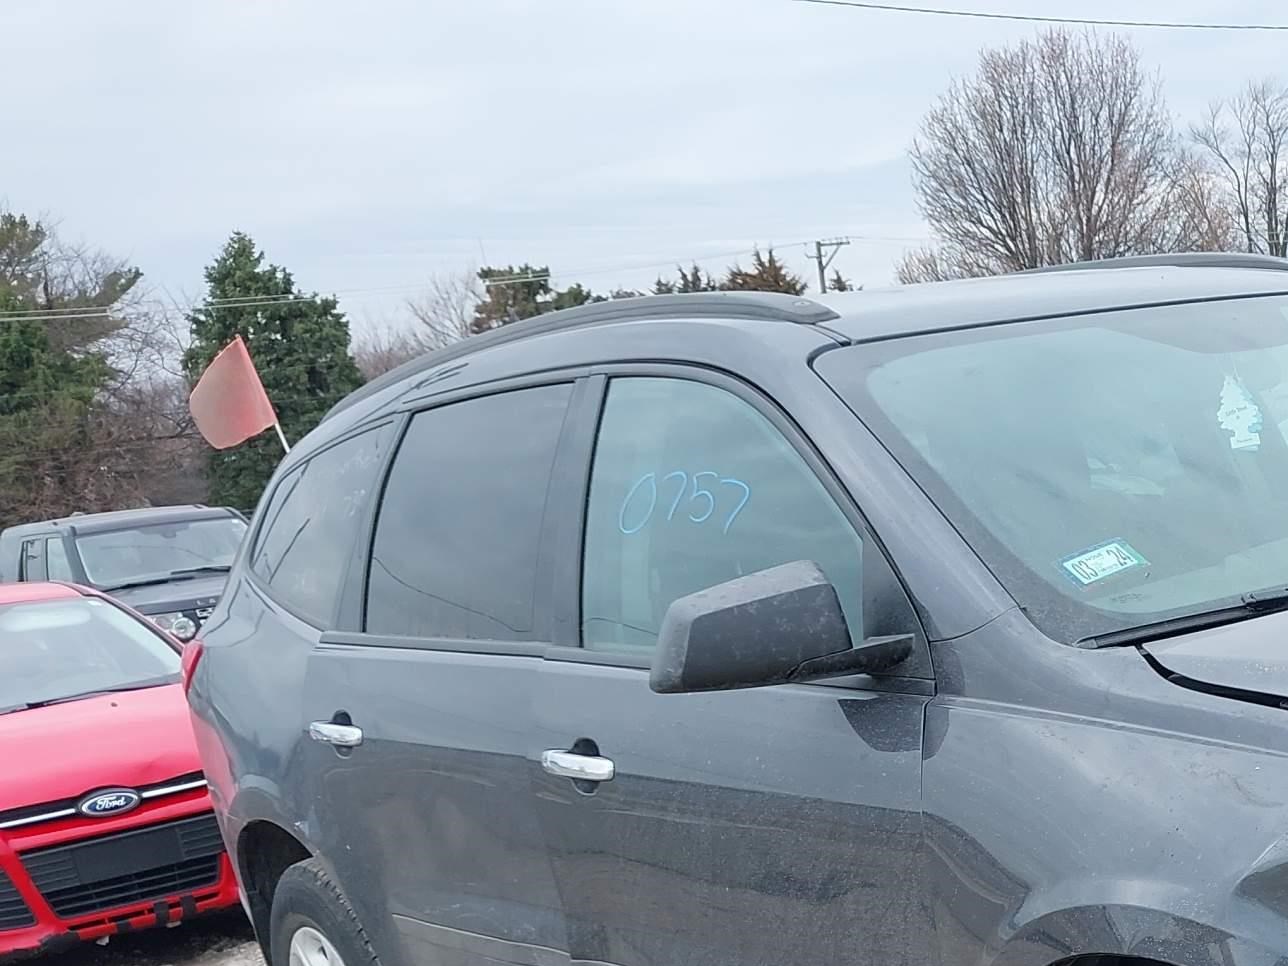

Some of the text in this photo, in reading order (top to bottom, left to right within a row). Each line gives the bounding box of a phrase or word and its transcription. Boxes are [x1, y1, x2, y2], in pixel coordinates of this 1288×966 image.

[619, 471, 751, 535] 0757
[1071, 560, 1099, 580] 03
[96, 796, 126, 810] Ford
